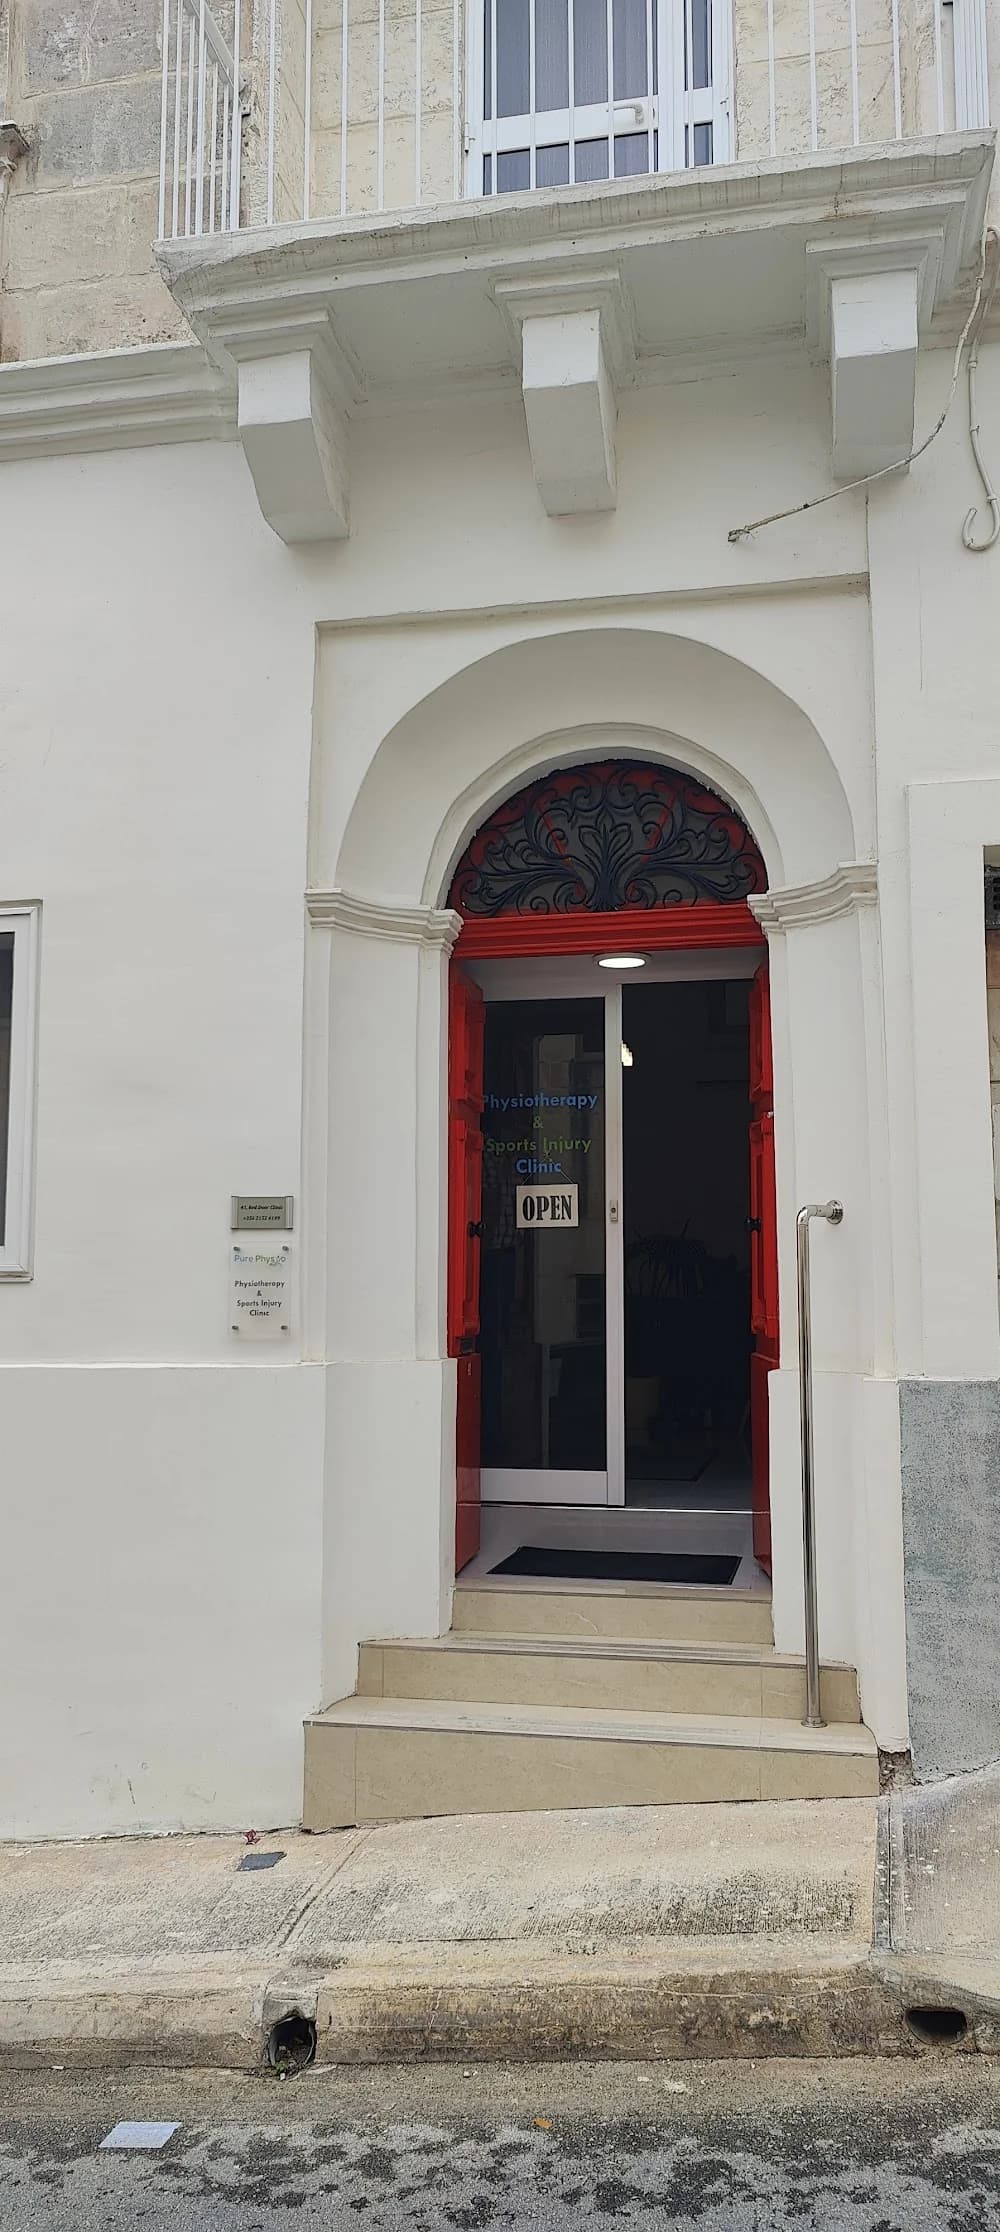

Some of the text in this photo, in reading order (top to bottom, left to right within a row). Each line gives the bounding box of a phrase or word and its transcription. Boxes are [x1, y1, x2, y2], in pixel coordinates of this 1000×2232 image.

[532, 1115, 544, 1129] &
[486, 1137, 592, 1155] Sports Injury
[516, 1158, 562, 1174] Clinic
[522, 1195, 572, 1221] OPEN
[234, 1254, 254, 1263] Pure
[234, 1280, 285, 1288] Physiotherapy
[236, 1300, 282, 1308] Sports Injury
[249, 1309, 270, 1317] Clinic
